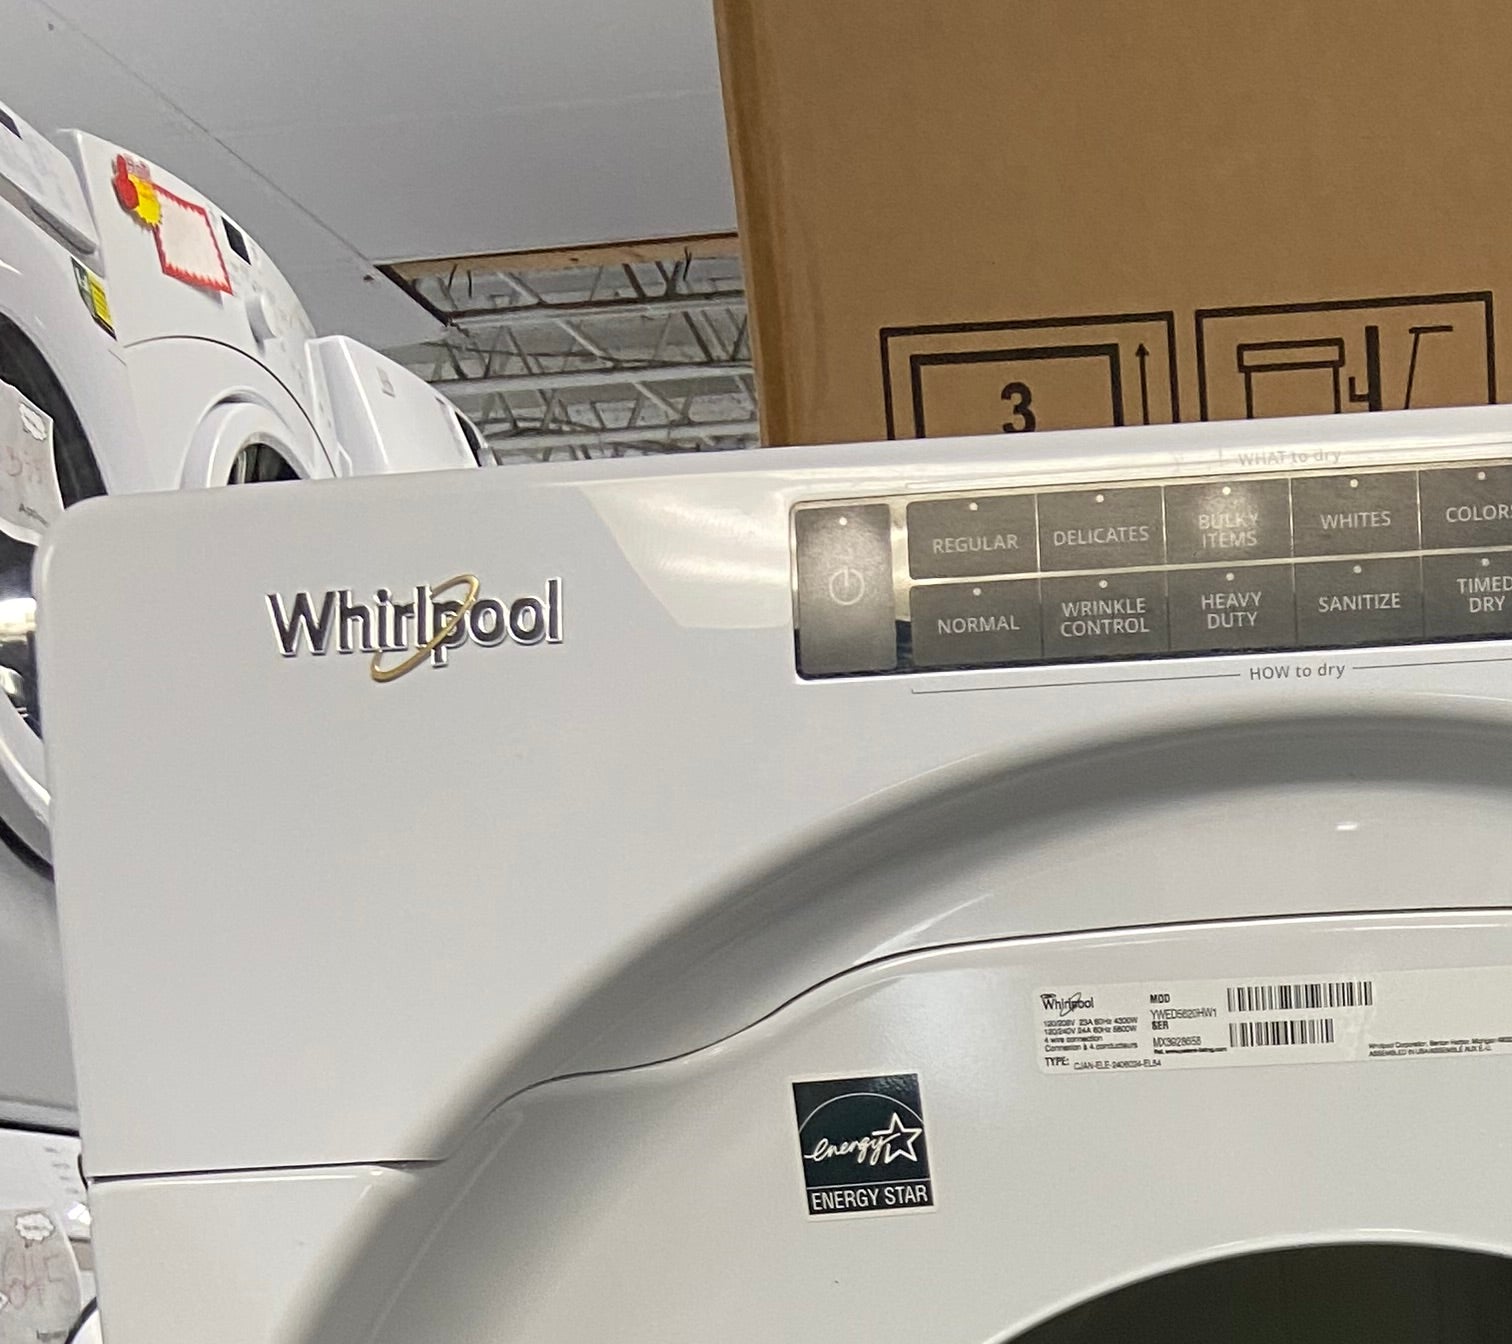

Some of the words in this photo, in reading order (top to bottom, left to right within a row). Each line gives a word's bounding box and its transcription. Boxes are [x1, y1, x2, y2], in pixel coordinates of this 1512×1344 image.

[1001, 381, 1036, 433] 3
[1239, 450, 1287, 466] WHAT
[1290, 450, 1306, 464] to
[1310, 448, 1340, 465] dry
[1199, 512, 1260, 529] BULKY
[1321, 510, 1390, 530] WHITES
[933, 534, 1018, 554] REGULAR
[1054, 526, 1149, 546] DELICATES
[1202, 531, 1257, 548] ITEMS
[1062, 598, 1146, 617] WRINKLE
[1202, 592, 1262, 609] HEAVY
[1318, 593, 1400, 612] SANITIZE
[1469, 595, 1505, 614] DRY
[266, 577, 562, 668] Whirlpool
[938, 616, 1019, 634] NORMAL
[1061, 619, 1149, 638] CONTROL
[1208, 612, 1258, 629] DUTY
[1250, 664, 1290, 680] HOW
[1295, 664, 1312, 678] to
[1316, 662, 1345, 680] dry
[1150, 994, 1170, 1003] MOD
[1152, 1021, 1169, 1029] SER
[1045, 1057, 1069, 1066] TYPE:
[804, 1134, 900, 1166] energy
[812, 1188, 879, 1211] ENERGY
[884, 1185, 928, 1205] STAR
